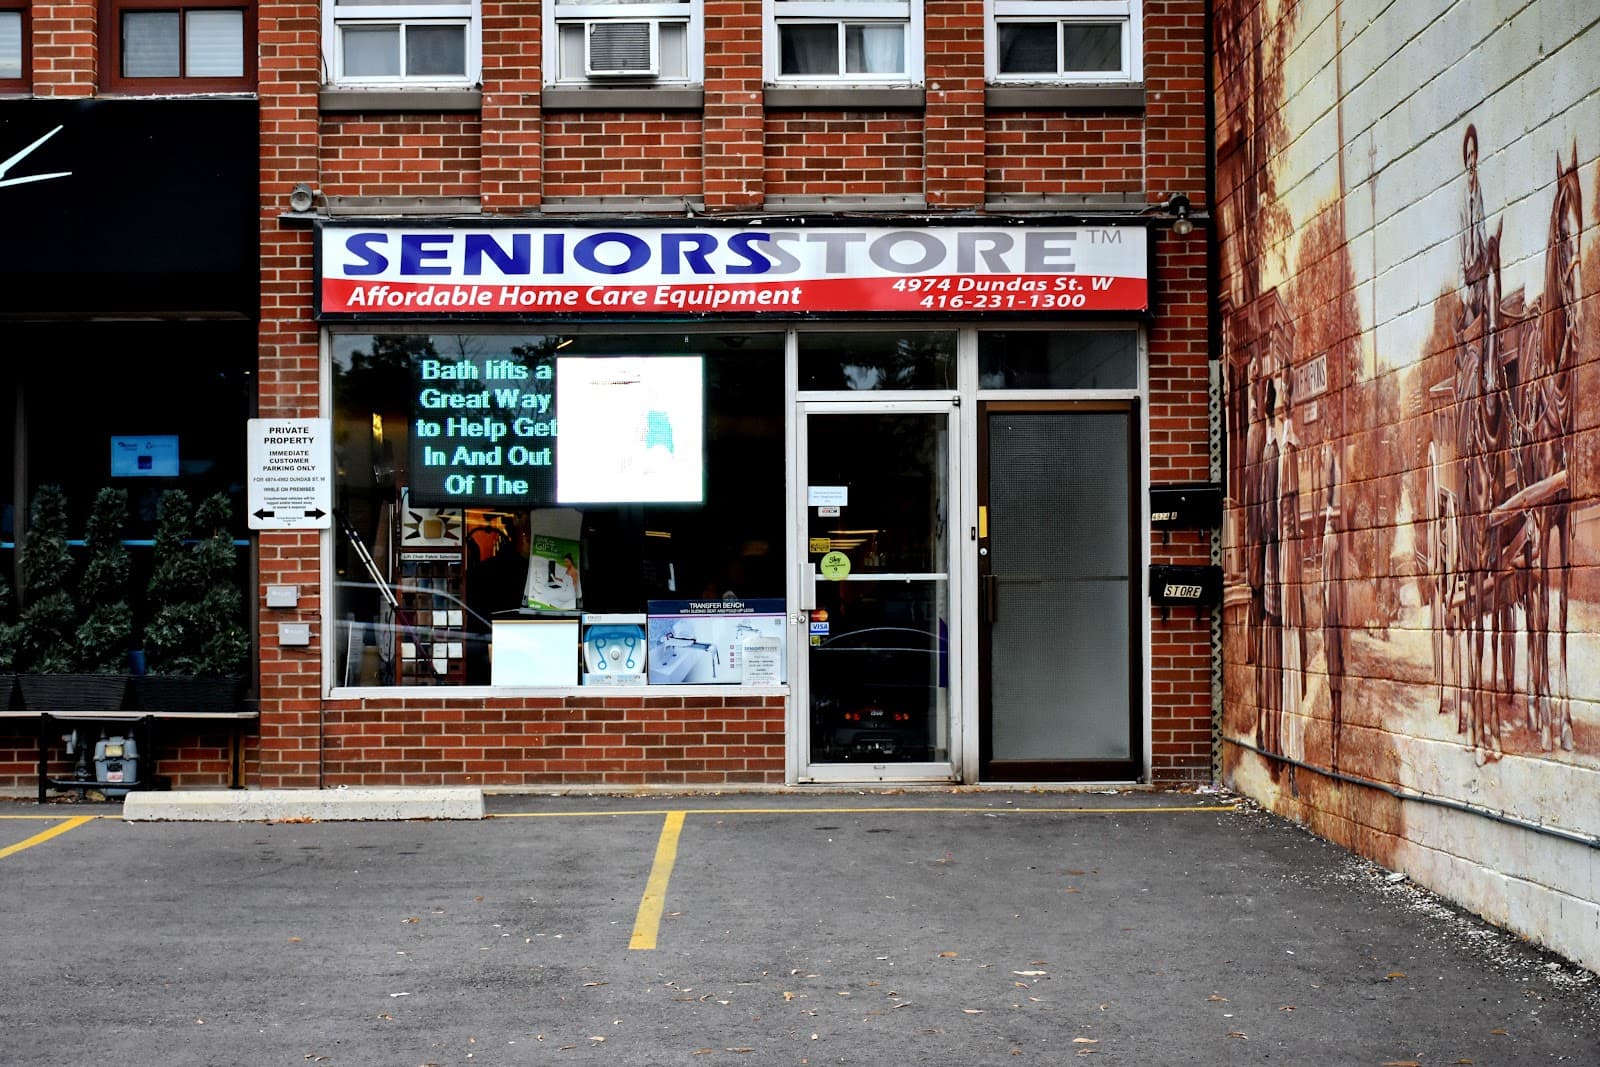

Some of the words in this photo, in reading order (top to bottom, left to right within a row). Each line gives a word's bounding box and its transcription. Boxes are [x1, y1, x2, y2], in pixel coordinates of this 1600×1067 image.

[342, 231, 771, 275] SENIORS
[757, 230, 1077, 275] STORE
[891, 277, 951, 292] 4974
[957, 276, 1048, 292] Dundas
[1053, 276, 1083, 291] St.
[1090, 276, 1115, 291] W
[346, 285, 493, 307] Affordable
[498, 286, 577, 306] Home
[585, 287, 647, 306] Care
[653, 286, 801, 308] Equipment
[919, 293, 1087, 309] 416-231-1300
[422, 359, 478, 381] Bath
[484, 359, 529, 381] lifts
[535, 364, 552, 381] a
[420, 388, 490, 409] Great
[495, 388, 552, 411] Way
[416, 419, 440, 438] to
[446, 417, 507, 443] Help
[513, 417, 558, 438] Get
[424, 446, 446, 466] In
[451, 445, 502, 467] And
[507, 445, 552, 467] Out
[444, 474, 478, 495] Of
[482, 474, 529, 495] The
[1165, 586, 1200, 598] STORE
